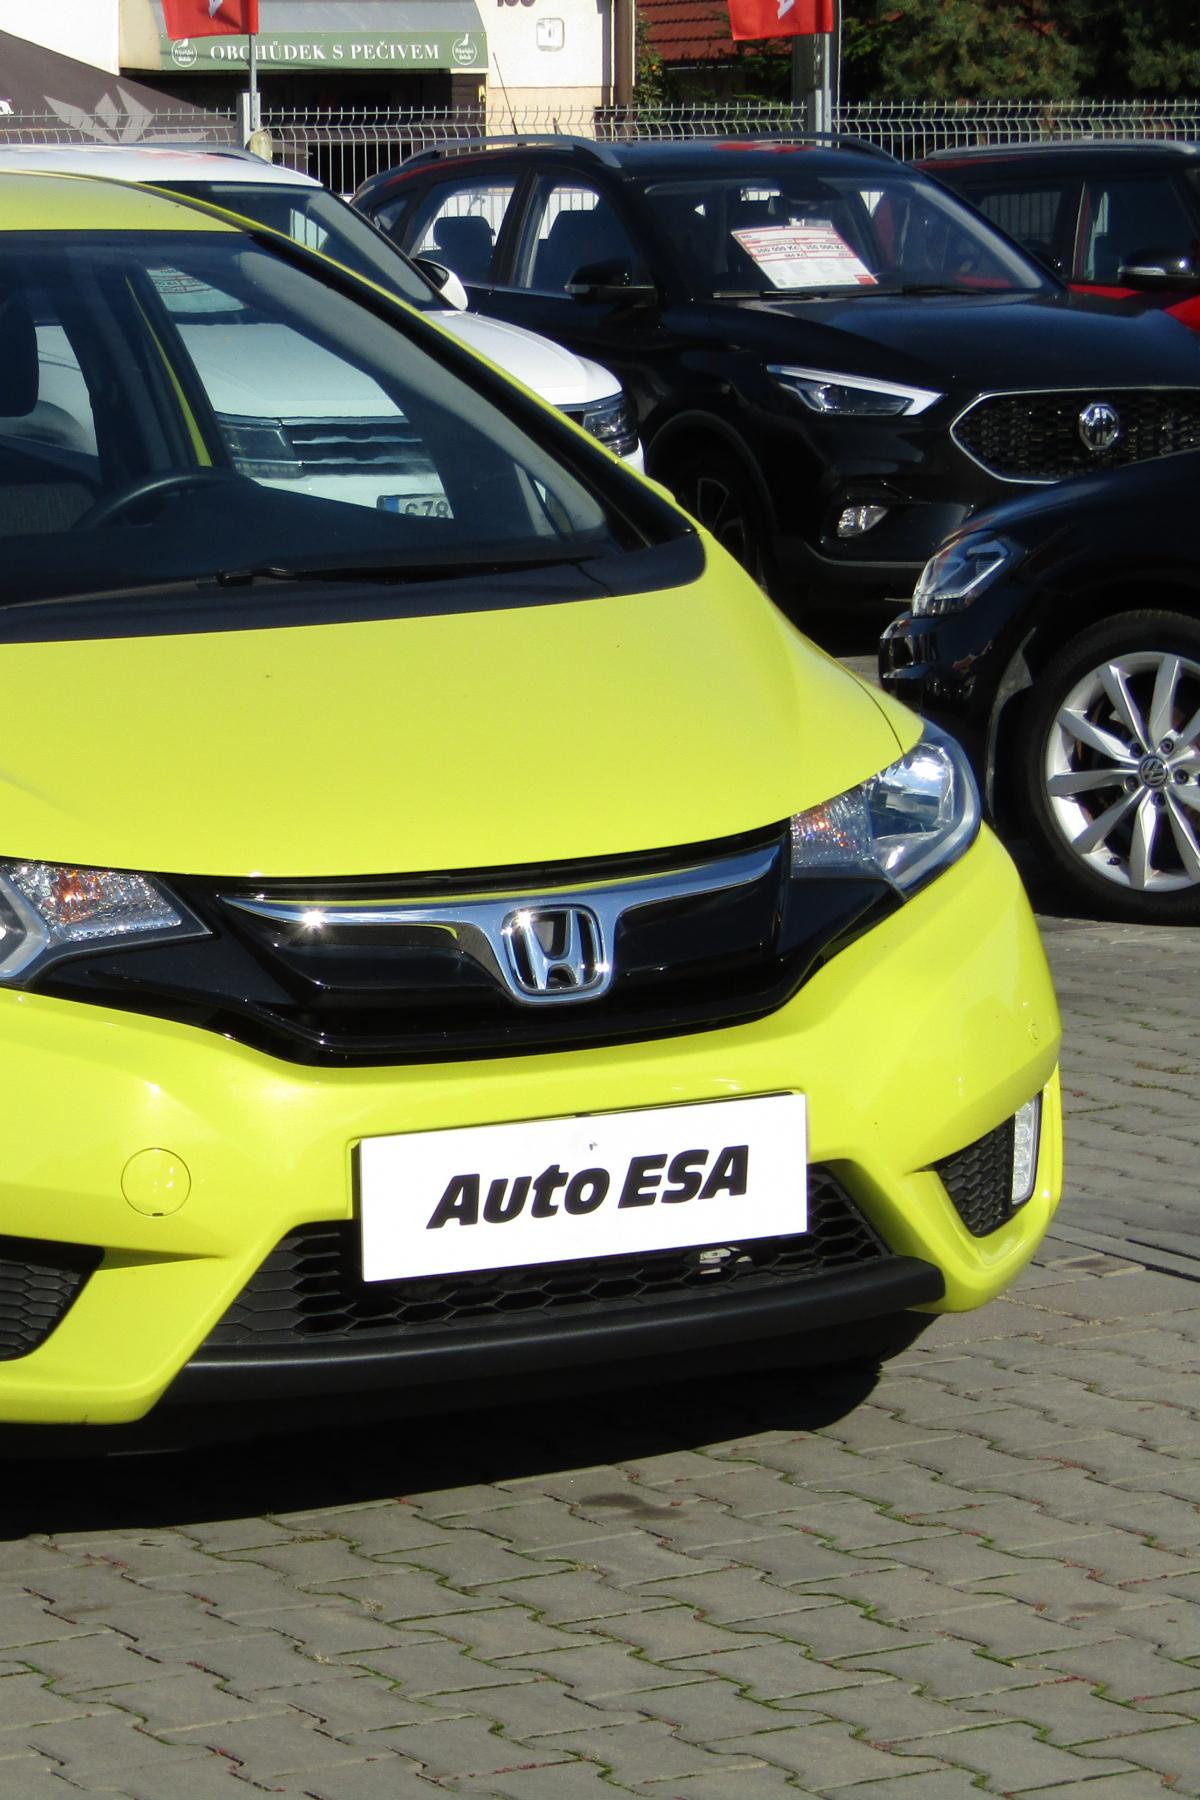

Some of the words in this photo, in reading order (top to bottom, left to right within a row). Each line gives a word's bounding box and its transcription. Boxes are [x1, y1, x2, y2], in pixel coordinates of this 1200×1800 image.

[332, 43, 344, 60] S
[351, 40, 440, 60] PEČIVEM
[426, 1164, 611, 1230] Auto
[618, 1144, 750, 1209] ESA
